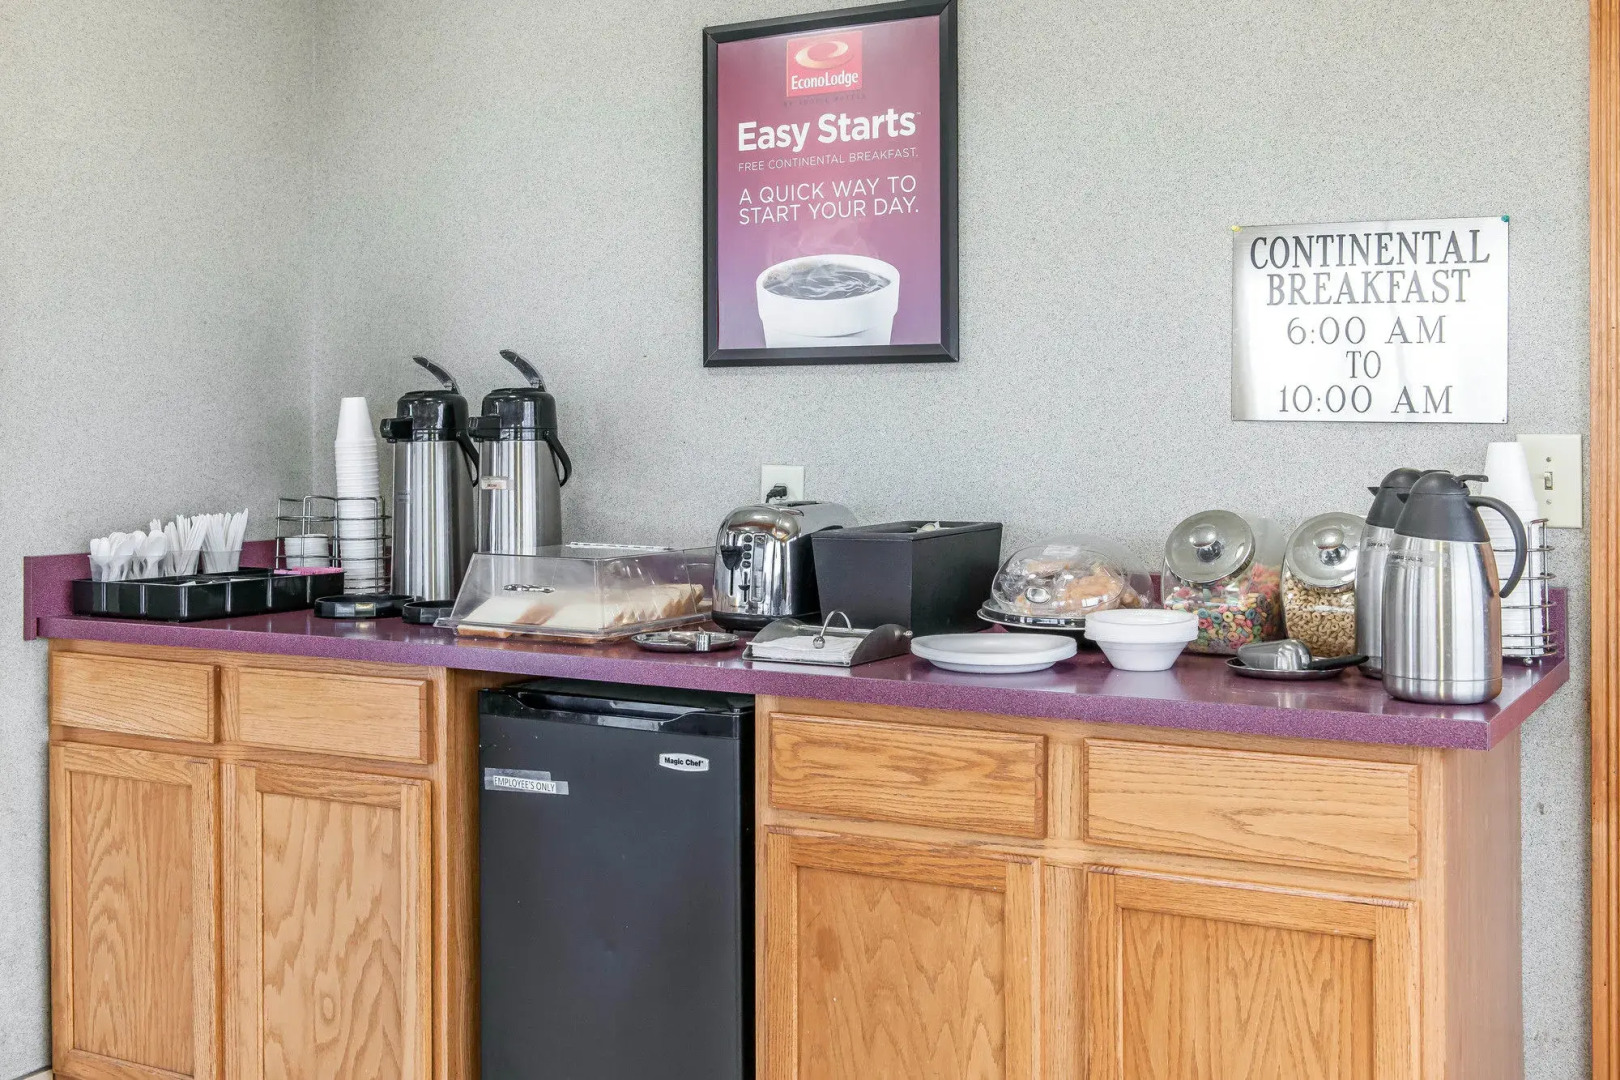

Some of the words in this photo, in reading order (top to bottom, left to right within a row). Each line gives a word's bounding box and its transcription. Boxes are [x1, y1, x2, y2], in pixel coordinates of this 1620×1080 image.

[791, 70, 859, 90] EconoLodge
[738, 121, 811, 153] Easy
[738, 161, 765, 172] FREE
[768, 153, 846, 170] CONTINENTAL
[849, 147, 919, 163] BREAKFAST.
[739, 188, 752, 205] A
[759, 181, 825, 204] QUICK
[831, 177, 880, 198] WAY
[887, 175, 917, 194] TO
[739, 204, 801, 225] START
[808, 199, 866, 220] YOUR
[874, 196, 919, 216] DAY.
[1250, 229, 1491, 269] CONTINENTAL
[1266, 269, 1471, 306] BREAKFAST
[1286, 316, 1366, 345] 6:00
[1384, 315, 1447, 344] AM
[1346, 350, 1382, 379] TO
[1279, 385, 1373, 413] 10:00
[1391, 385, 1454, 414] AM
[664, 756, 684, 766] Magic
[494, 776, 535, 790] EMPLOYEE'S
[536, 782, 555, 792] ONLY
